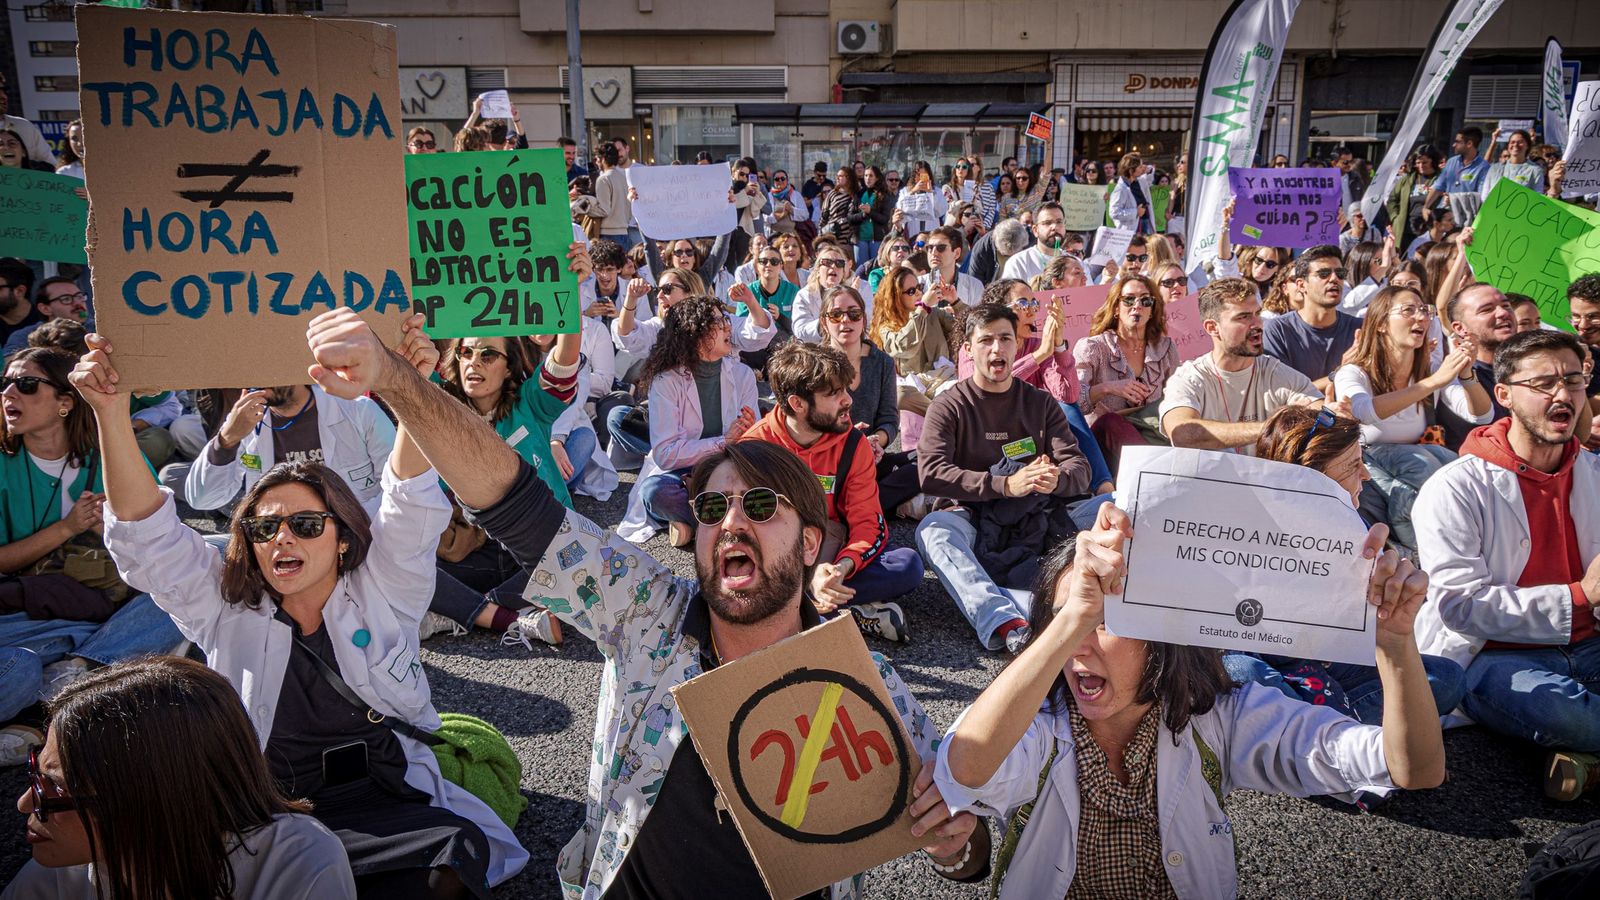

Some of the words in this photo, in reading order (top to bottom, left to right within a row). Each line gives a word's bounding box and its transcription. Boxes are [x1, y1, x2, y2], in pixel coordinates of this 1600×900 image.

[123, 26, 280, 77] HORA
[82, 81, 395, 140] TRABAJADA
[1199, 78, 1255, 177] SMA
[406, 154, 547, 211] cación
[122, 207, 279, 256] HORA
[417, 218, 465, 253] NO
[489, 216, 532, 248] ES
[1483, 224, 1530, 264] NO
[121, 269, 411, 319] COTIZADA
[285, 451, 306, 462] I'M
[1163, 518, 1245, 542] DERECHO
[1248, 530, 1260, 544] A
[1265, 531, 1354, 556] NEGOCIAR
[1176, 545, 1207, 562] MIS
[1212, 549, 1331, 577] CONDICIONES
[1199, 625, 1239, 639] Estatuto
[1241, 630, 1256, 640] del
[1258, 632, 1293, 645] Médico
[750, 705, 895, 806] 24h
